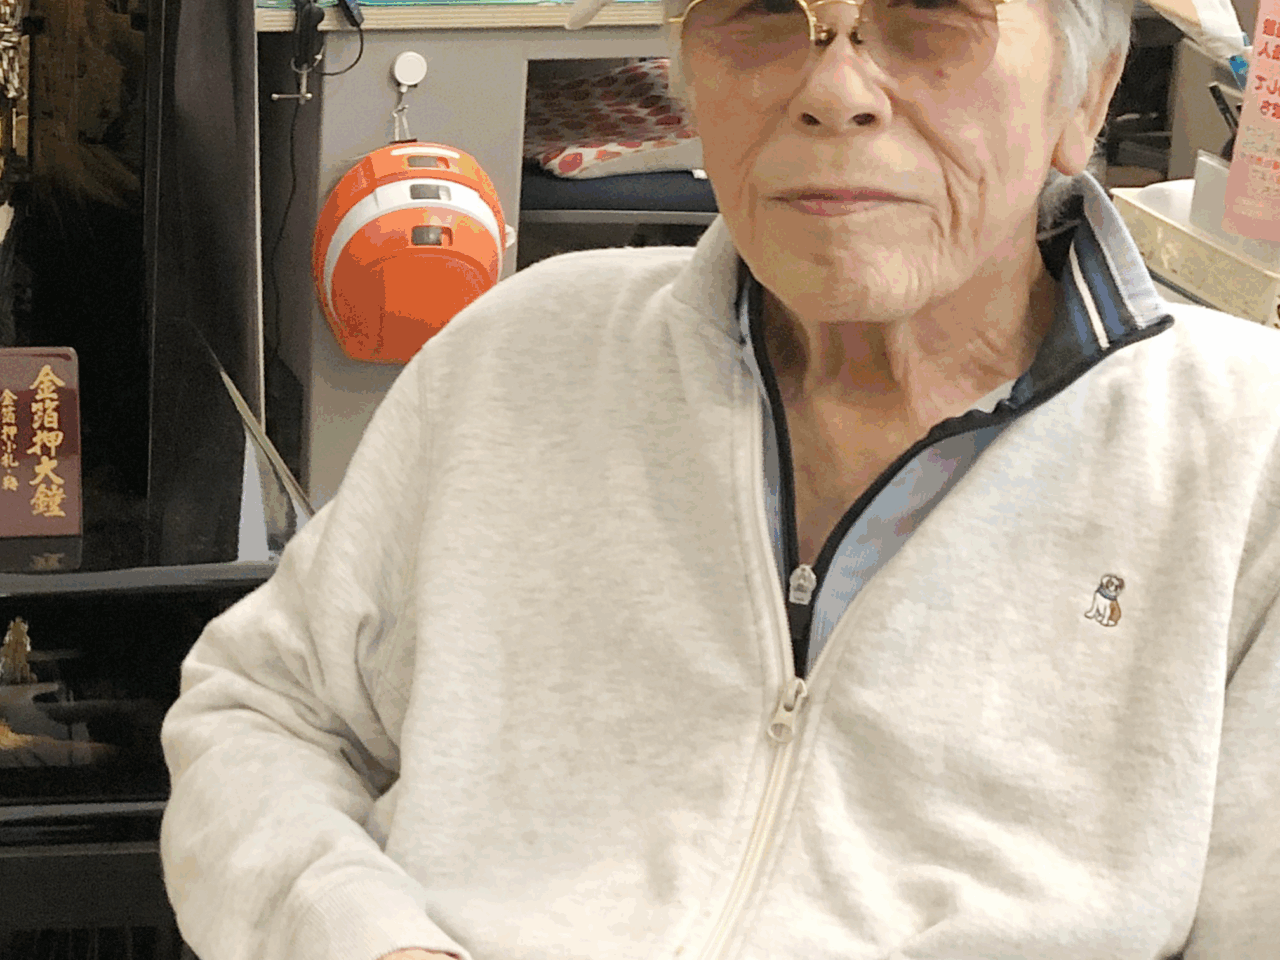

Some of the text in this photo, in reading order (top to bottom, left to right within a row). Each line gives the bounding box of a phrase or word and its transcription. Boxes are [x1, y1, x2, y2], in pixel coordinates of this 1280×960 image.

[26, 364, 66, 517] 金箔押大鎧
